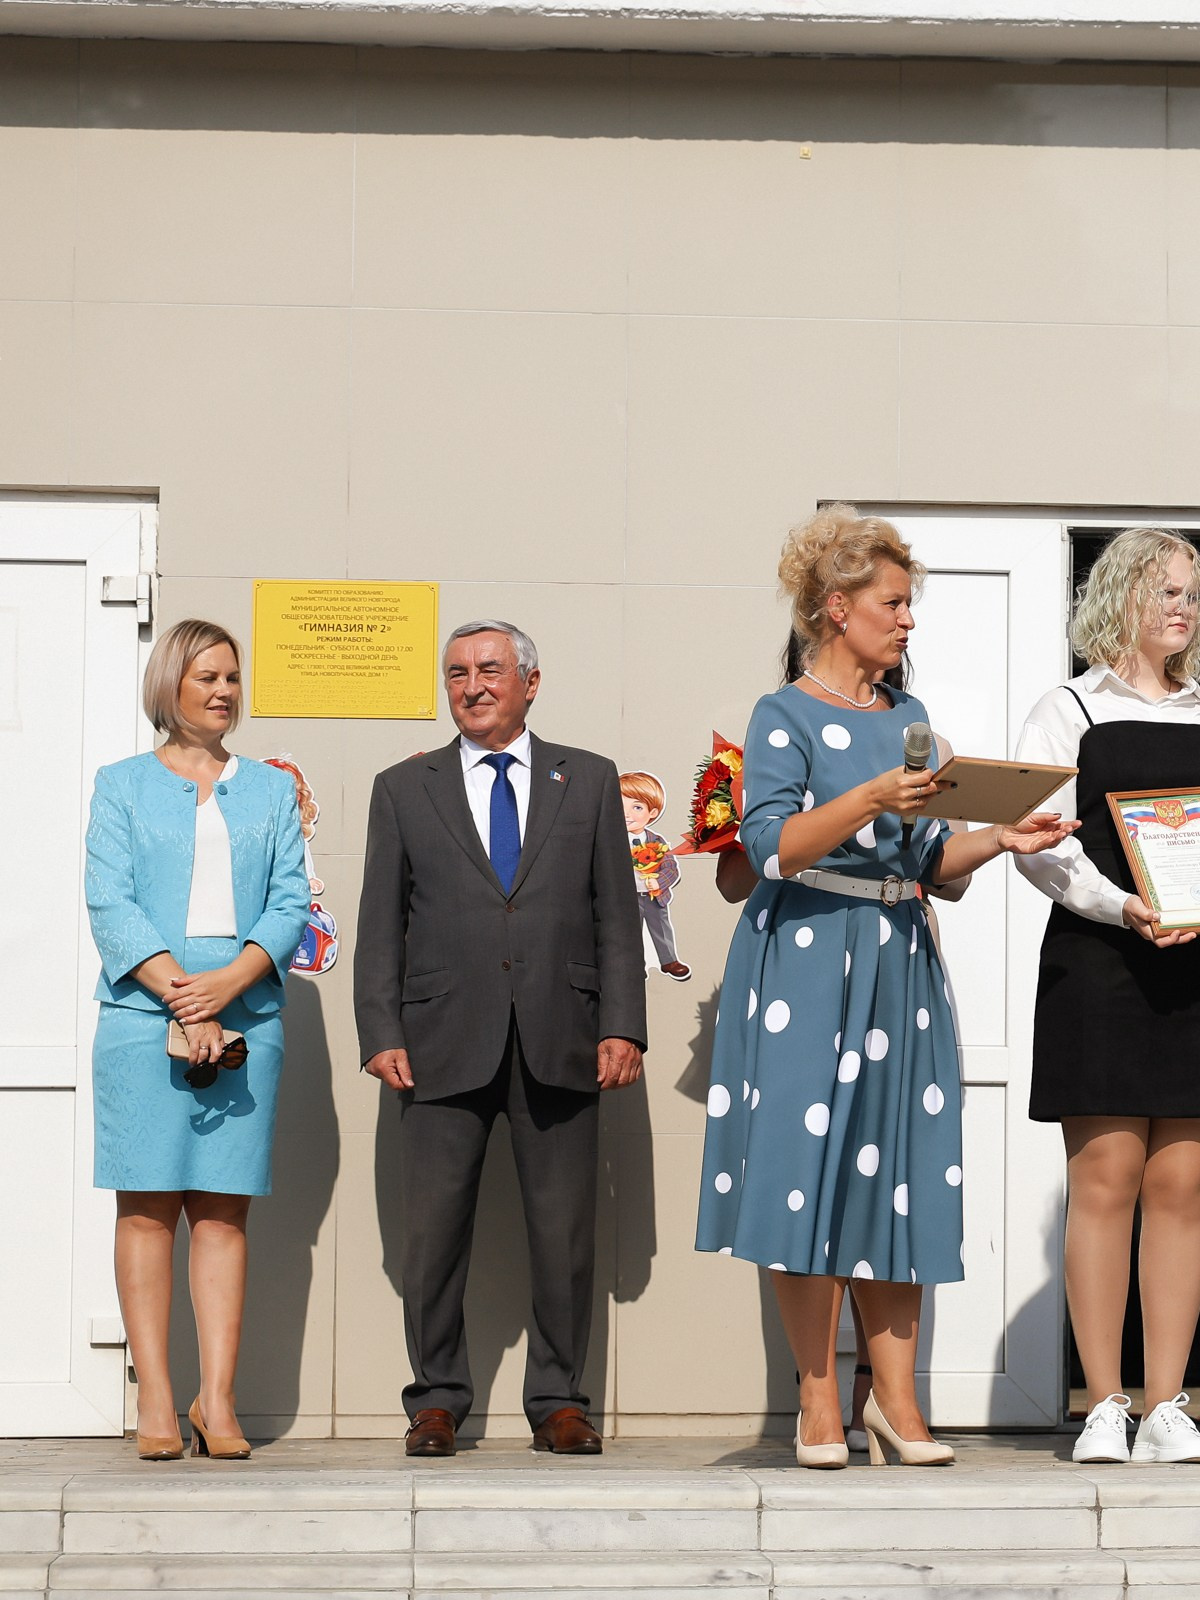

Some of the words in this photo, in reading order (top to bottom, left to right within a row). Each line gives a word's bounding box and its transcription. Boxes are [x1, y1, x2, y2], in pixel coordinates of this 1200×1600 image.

[299, 623, 363, 632] «ГИМНАЗИЯ
[367, 624, 377, 632] №
[380, 625, 391, 633] 2»
